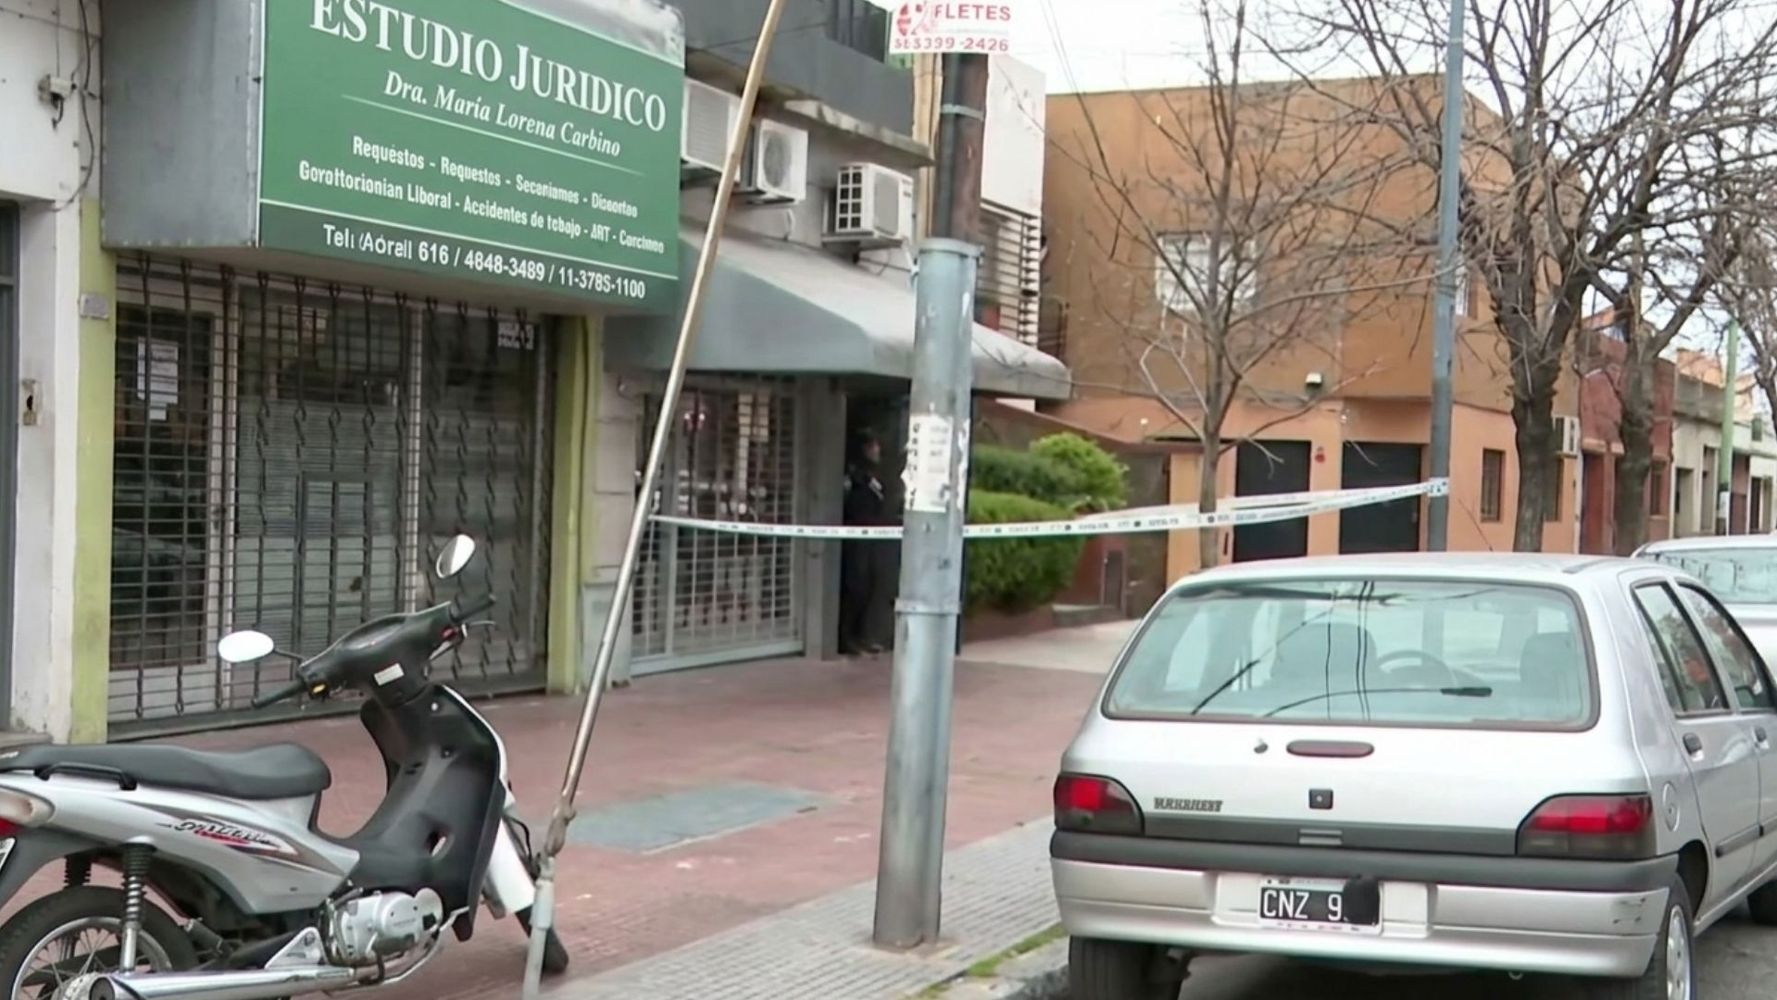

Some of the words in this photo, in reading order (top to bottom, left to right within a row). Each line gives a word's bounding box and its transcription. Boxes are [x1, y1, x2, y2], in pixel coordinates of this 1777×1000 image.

[310, 0, 503, 83] ESTUDIO
[509, 44, 667, 132] JURIDICO
[383, 70, 428, 106] Dra.
[433, 84, 491, 122] María
[496, 103, 556, 141] Lorena
[560, 122, 621, 157] Carbino
[463, 195, 528, 225] Accidentes
[530, 211, 545, 228] de
[418, 240, 450, 266] 616
[463, 249, 546, 283] 4848-3489
[1262, 889, 1310, 920] CNZ
